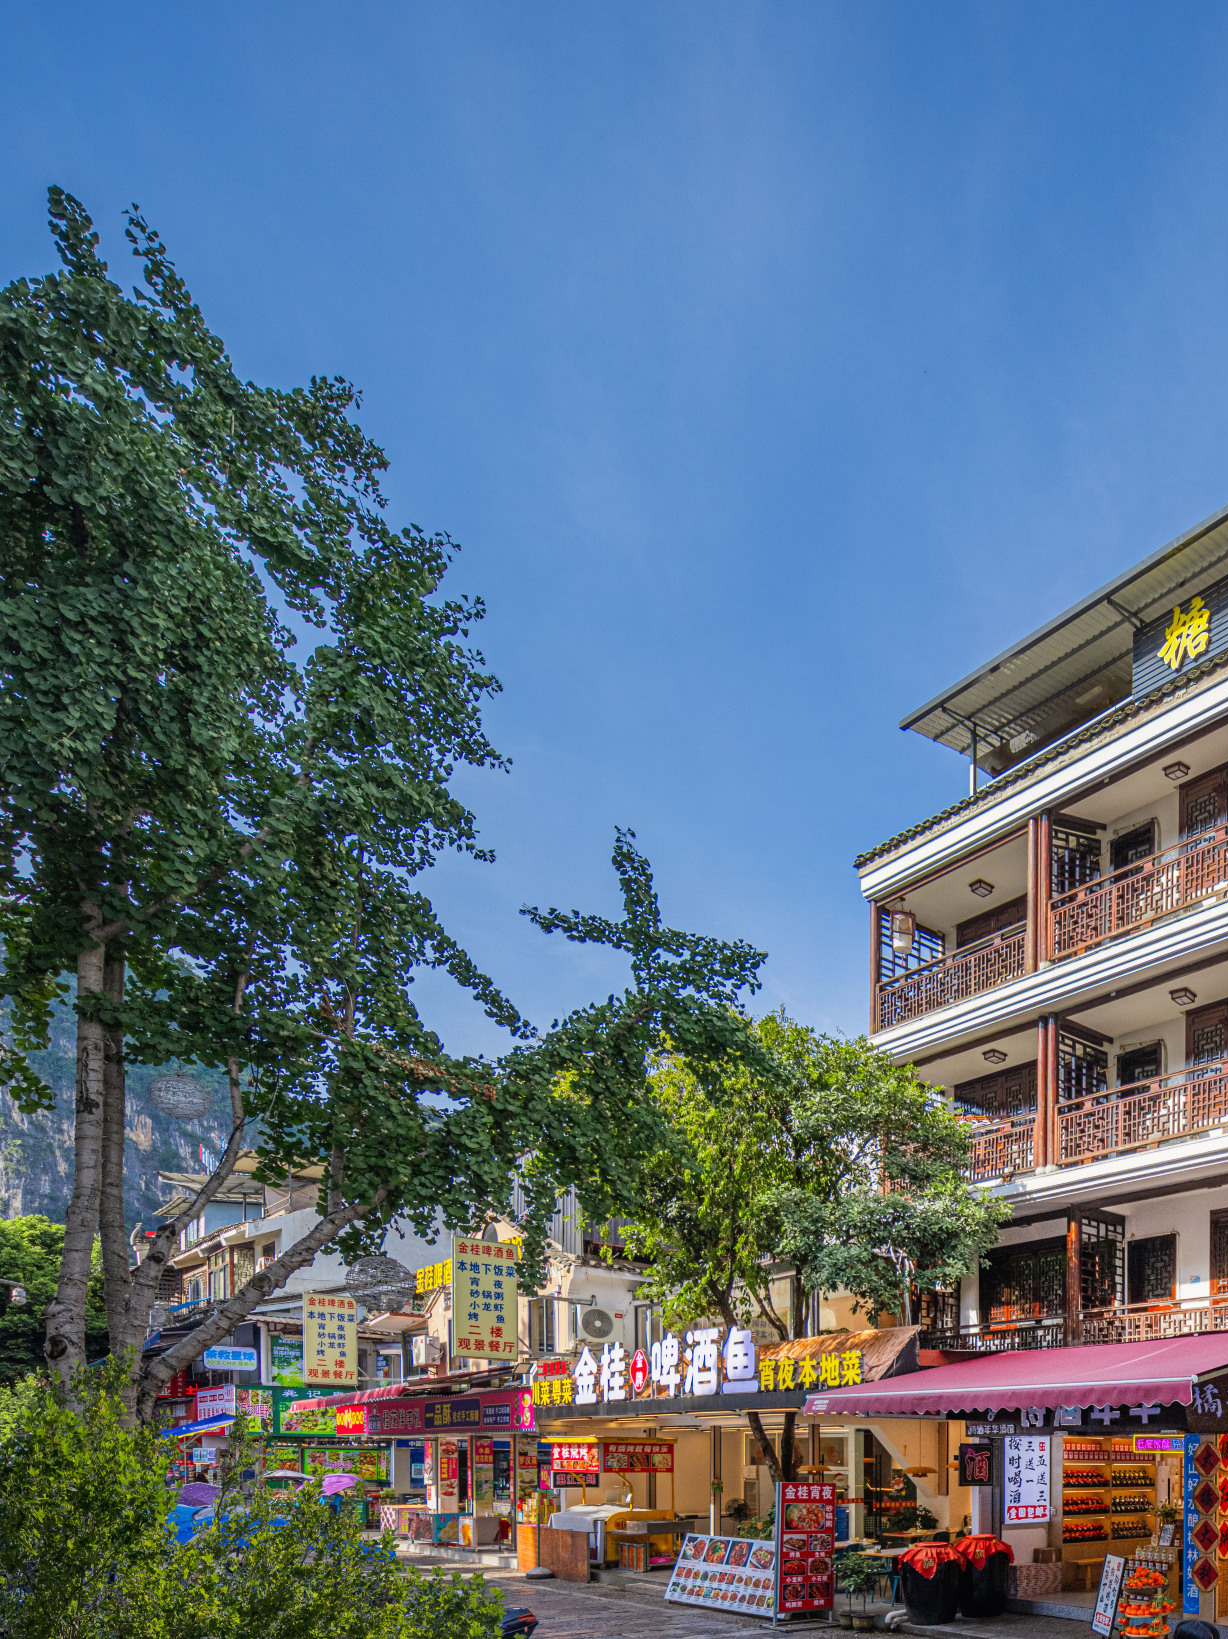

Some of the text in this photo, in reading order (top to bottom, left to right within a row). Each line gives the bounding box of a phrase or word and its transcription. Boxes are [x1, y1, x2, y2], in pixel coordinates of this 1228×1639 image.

[457, 1241, 515, 1260] 金桂啤酒鱼
[457, 1260, 516, 1278] 本地下饭菜
[469, 1276, 504, 1290] 宵夜
[469, 1289, 504, 1301] 砂锅粥
[307, 1296, 355, 1310] 金桂啤酒鱼
[469, 1301, 504, 1313] 小龙虾
[307, 1310, 355, 1323] 本地下饭菜
[467, 1312, 506, 1324] 烤鱼
[317, 1323, 346, 1332] 宵夜
[468, 1324, 504, 1339] 二楼
[317, 1331, 346, 1341] 砂锅粥
[317, 1341, 346, 1350] 小龙虾
[457, 1337, 516, 1354] 观景餐厅
[316, 1349, 347, 1358] 烤鱼
[316, 1358, 346, 1369] 二楼
[651, 1325, 760, 1397] 啤酒鱼
[307, 1368, 356, 1380] 观景餐厅
[759, 1349, 862, 1391] 宵夜本地菜
[531, 1377, 573, 1405] 川菜粤菜
[608, 1444, 670, 1453] 有烧烤就有快乐
[965, 1449, 991, 1482] 酒
[1024, 1440, 1036, 1483] 三送一
[1007, 1436, 1023, 1504] 按时喝酒
[1036, 1455, 1048, 1503] 五送三
[784, 1485, 833, 1500] 金桂宵夜
[1008, 1506, 1044, 1520] 全国包邮
